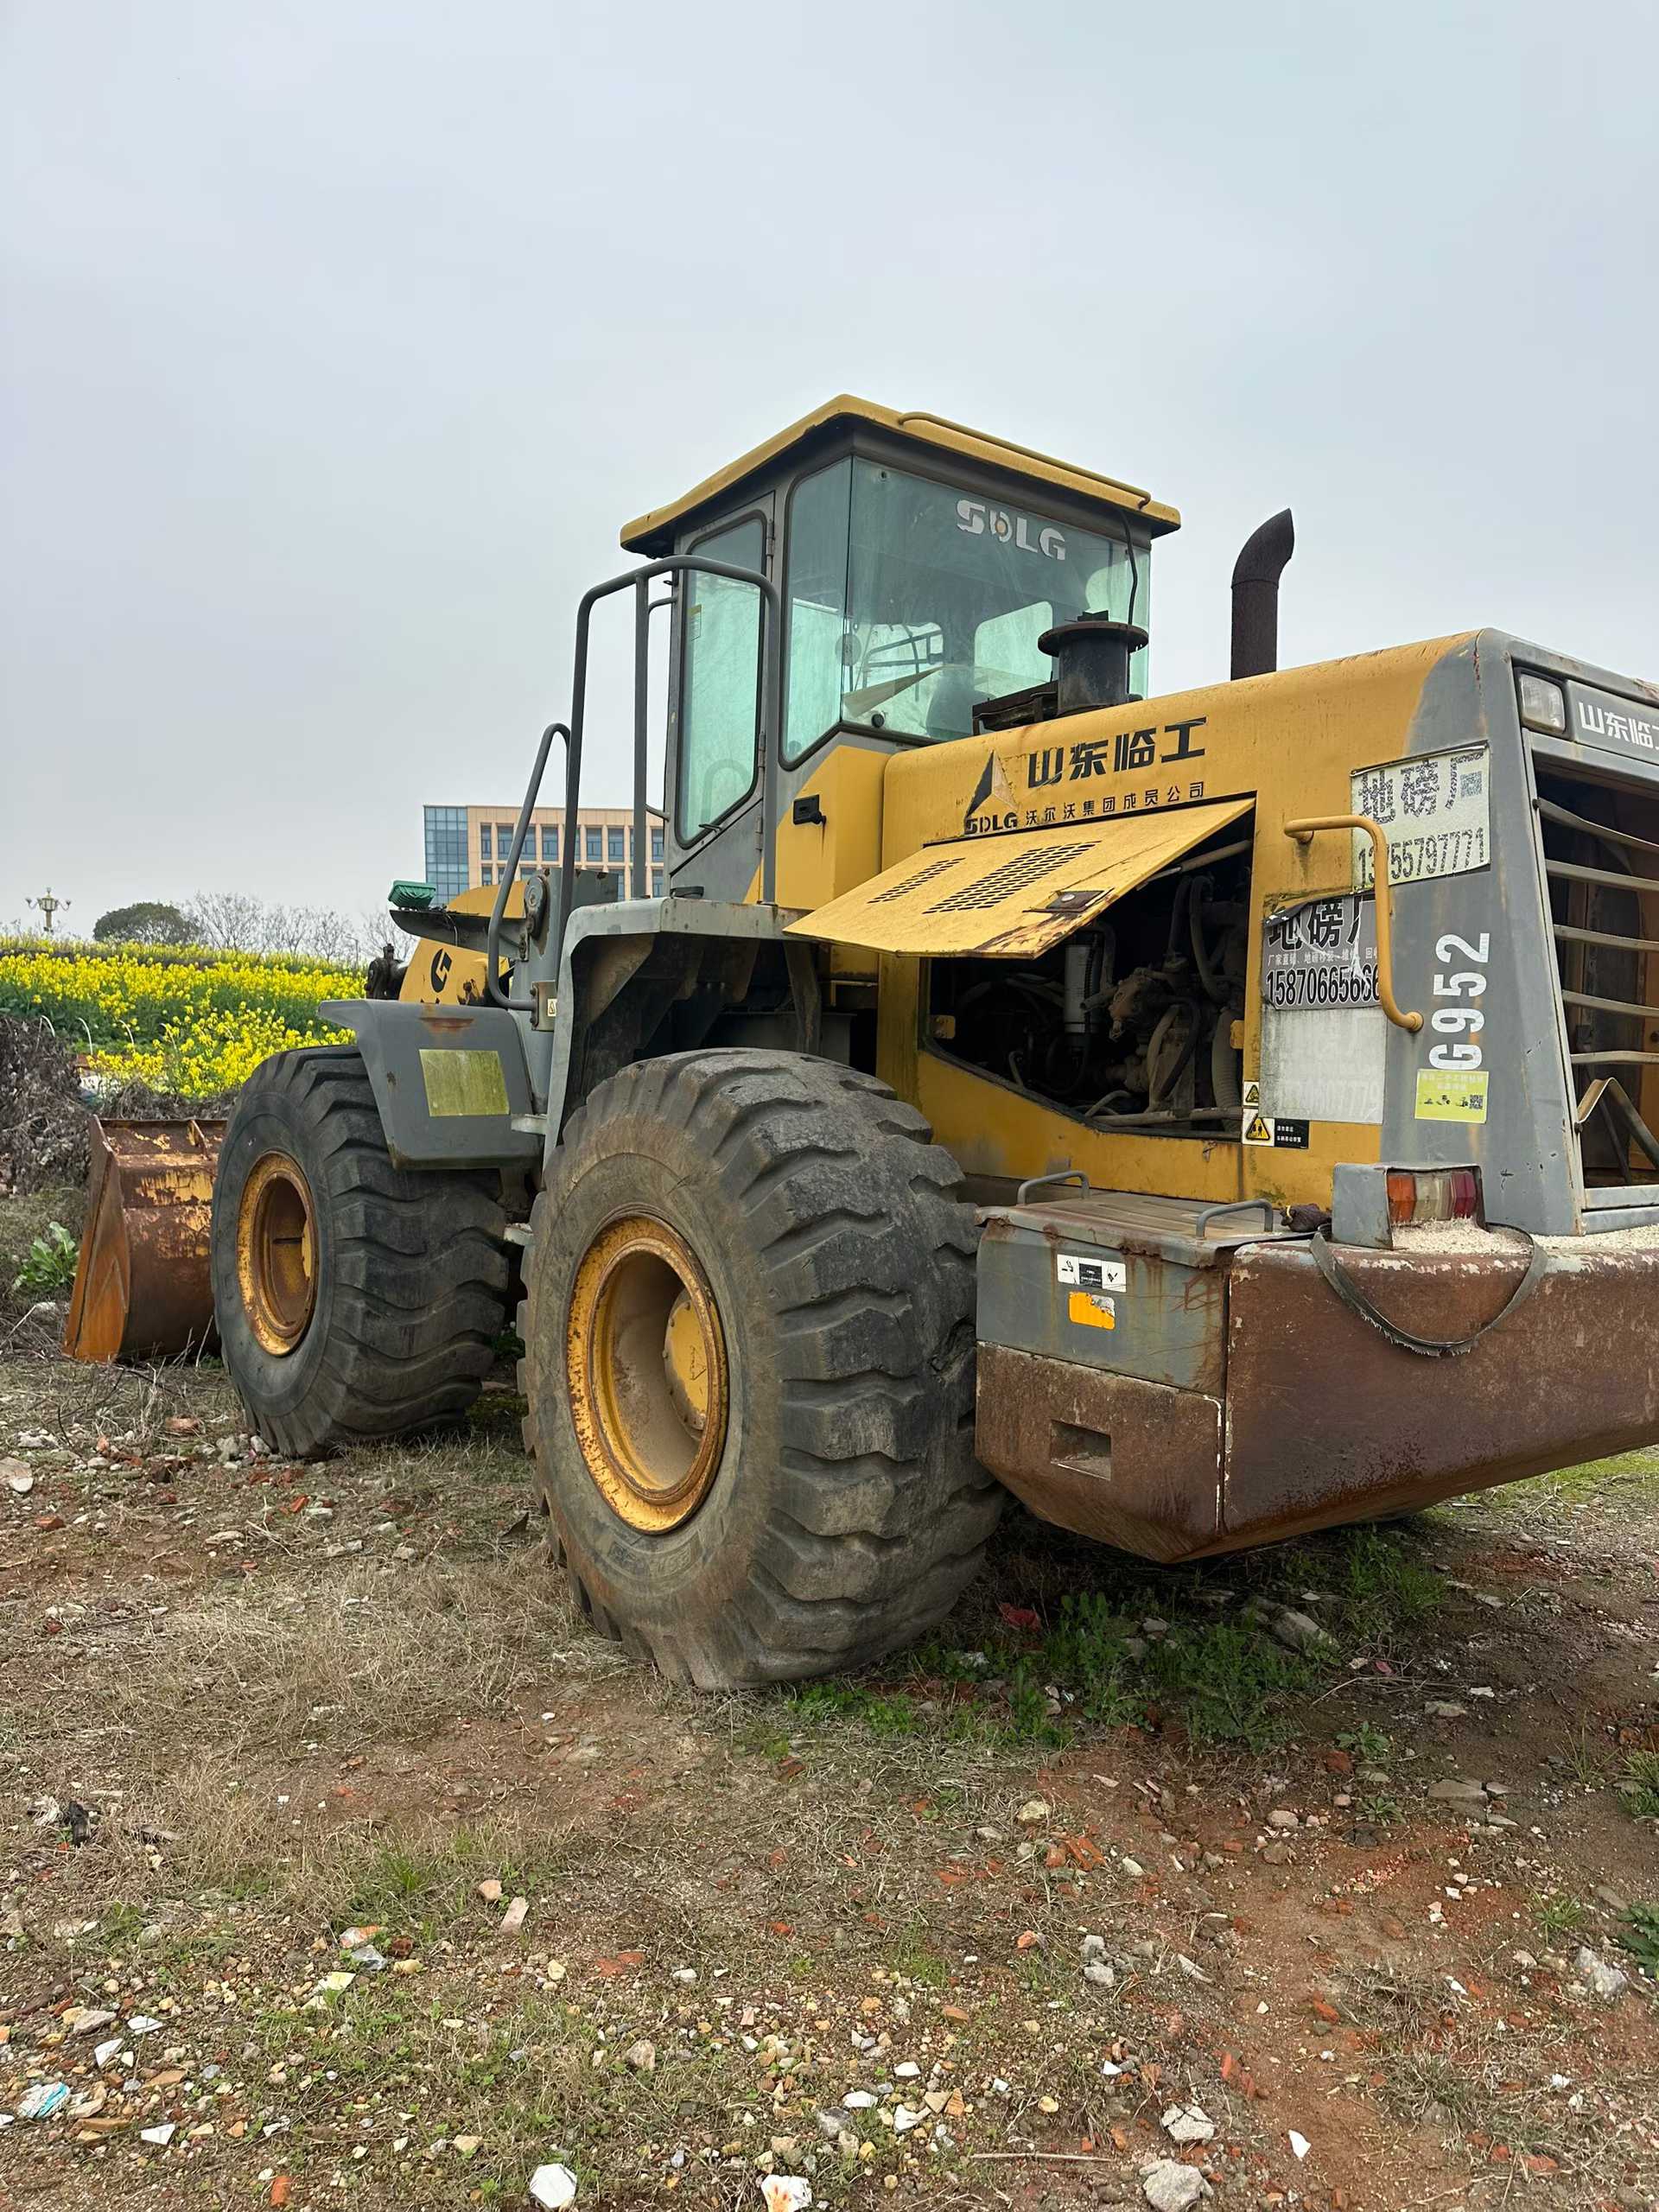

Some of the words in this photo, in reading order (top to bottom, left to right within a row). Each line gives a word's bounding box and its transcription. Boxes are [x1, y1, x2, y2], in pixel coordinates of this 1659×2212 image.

[956, 499, 1065, 561] SDLG
[1027, 715, 1207, 790] 山东临工
[1026, 781, 1205, 825] 沃尔沃集团成员公司
[1357, 751, 1484, 825] 地磅厂
[964, 811, 1018, 836] SDLG
[1428, 932, 1491, 1071] G952
